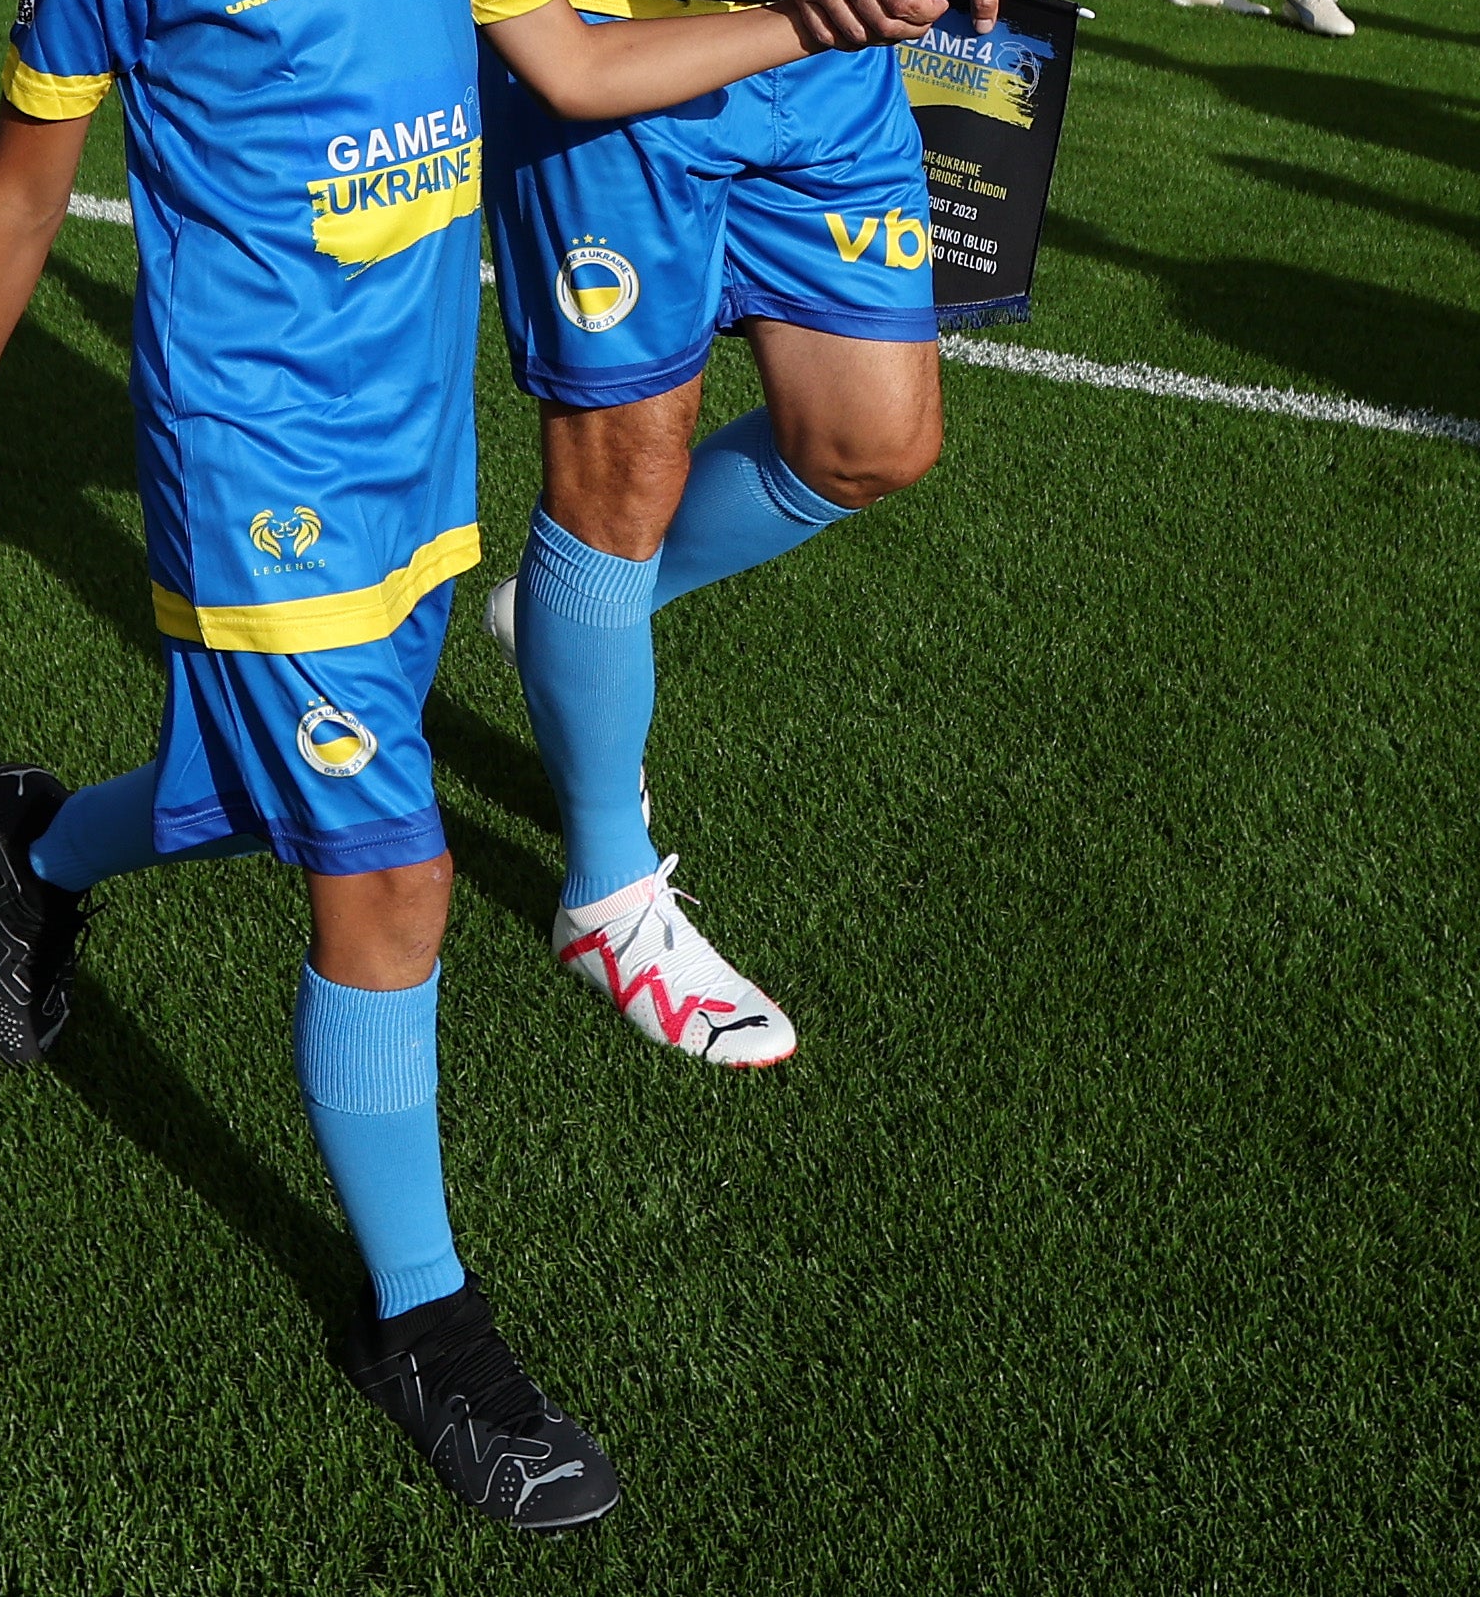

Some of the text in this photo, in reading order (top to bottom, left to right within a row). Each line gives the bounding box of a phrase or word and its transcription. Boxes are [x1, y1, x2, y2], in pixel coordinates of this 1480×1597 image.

[896, 46, 994, 93] UKRAINE
[327, 104, 467, 173] GAME4
[922, 149, 983, 178] ME4UKRAINE
[328, 147, 471, 216] UKRAINE
[929, 168, 965, 190] BRIDGE,
[967, 178, 1008, 201] LONDON
[928, 195, 978, 221] GUST 2023
[824, 206, 932, 270] vb
[962, 233, 998, 255] (BLUE)
[588, 250, 630, 275] UKRAINE
[946, 248, 997, 275] (YELLOW)
[253, 558, 326, 577] LEGENDS
